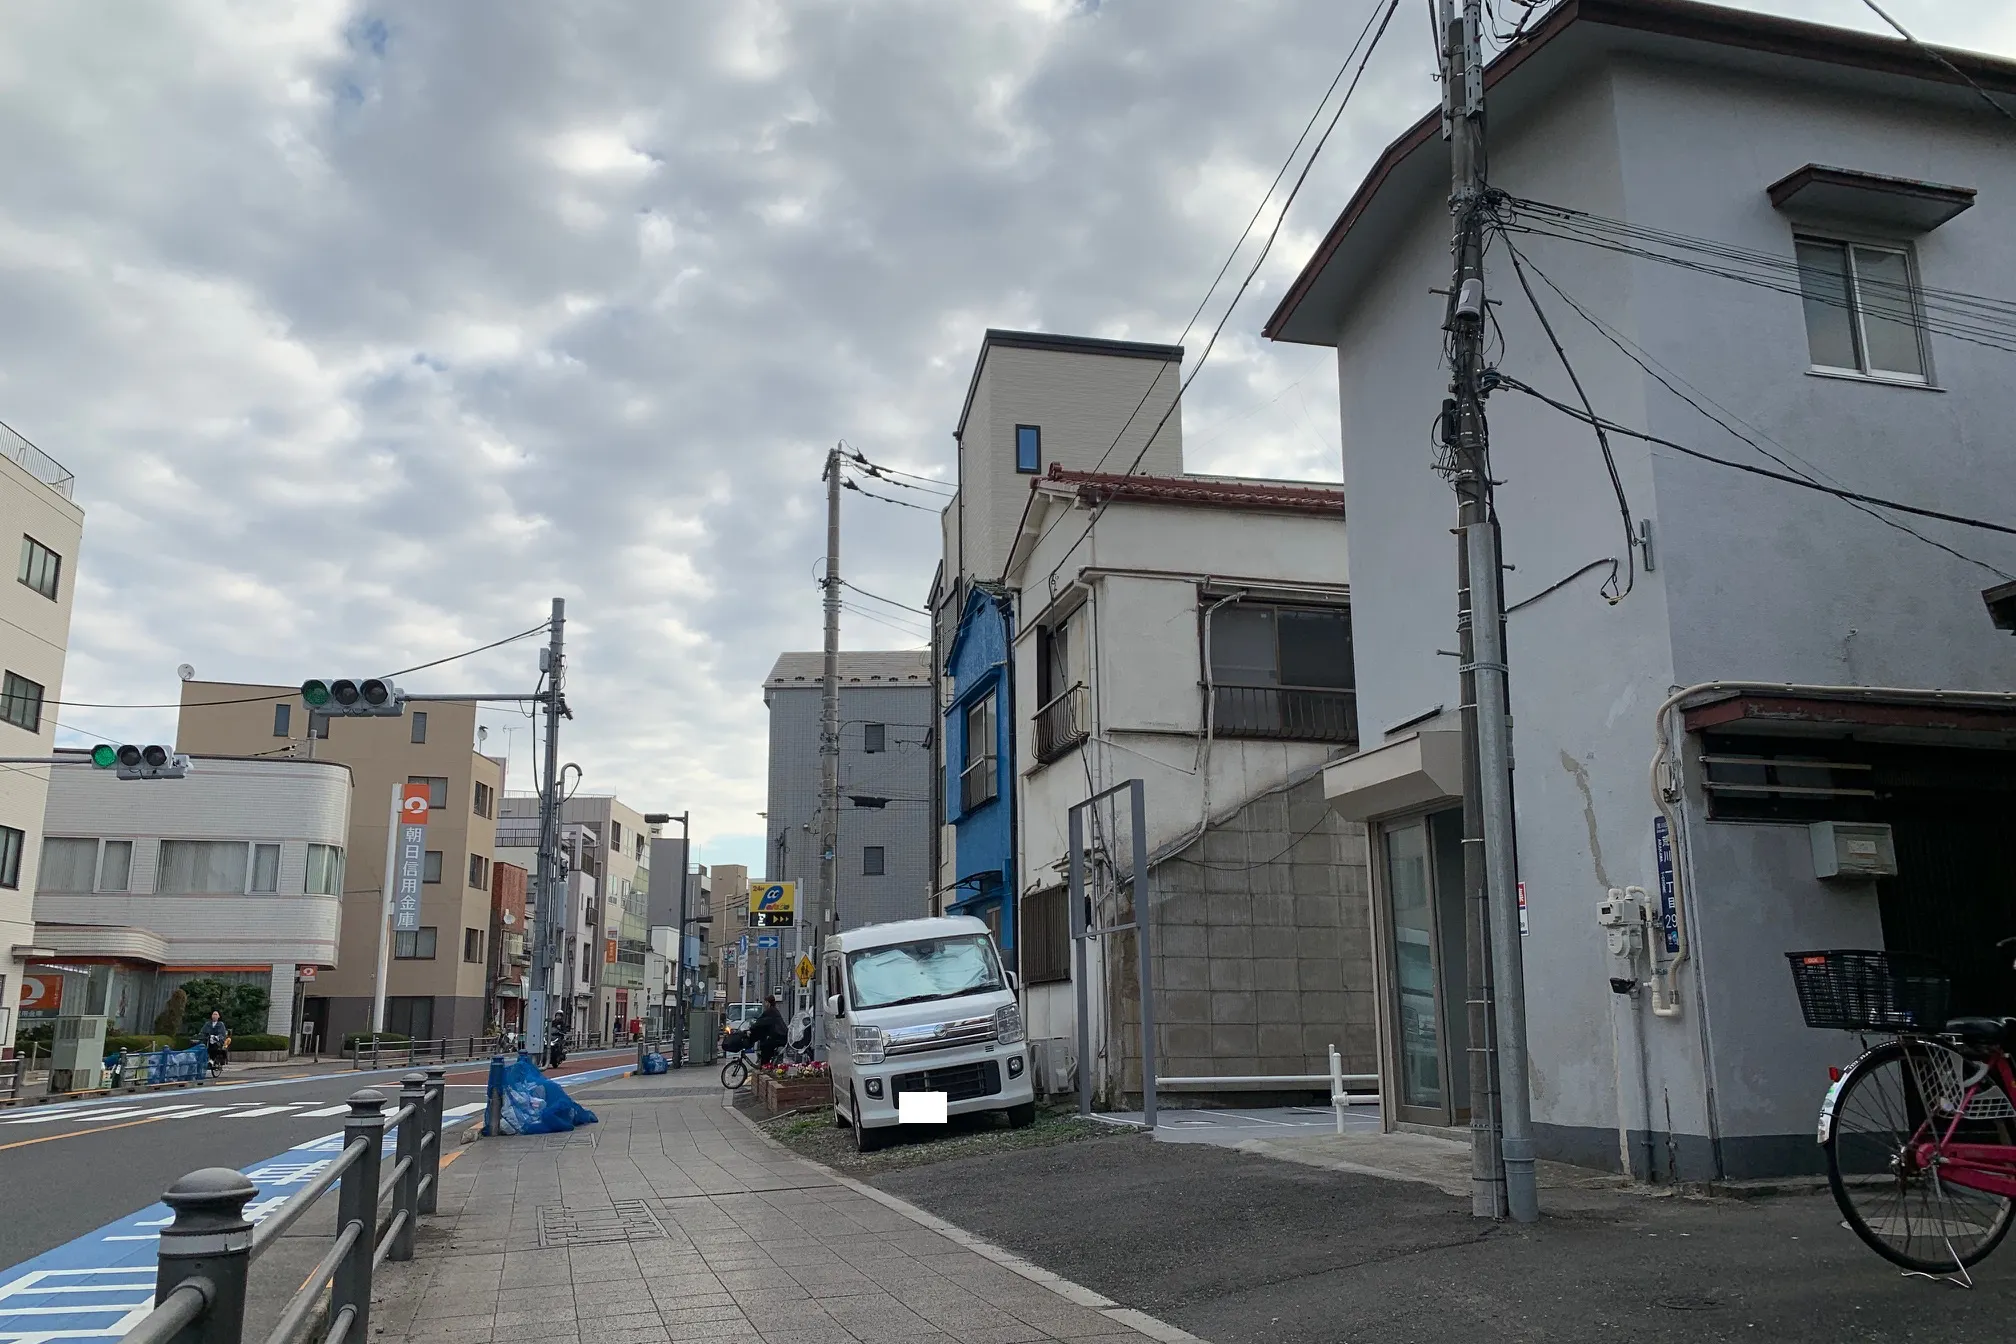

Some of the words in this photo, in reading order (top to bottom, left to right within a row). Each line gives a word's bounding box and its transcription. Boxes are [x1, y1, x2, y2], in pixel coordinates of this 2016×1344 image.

[397, 827, 422, 928] 朝日信用金庫
[1665, 914, 1678, 928] 29
